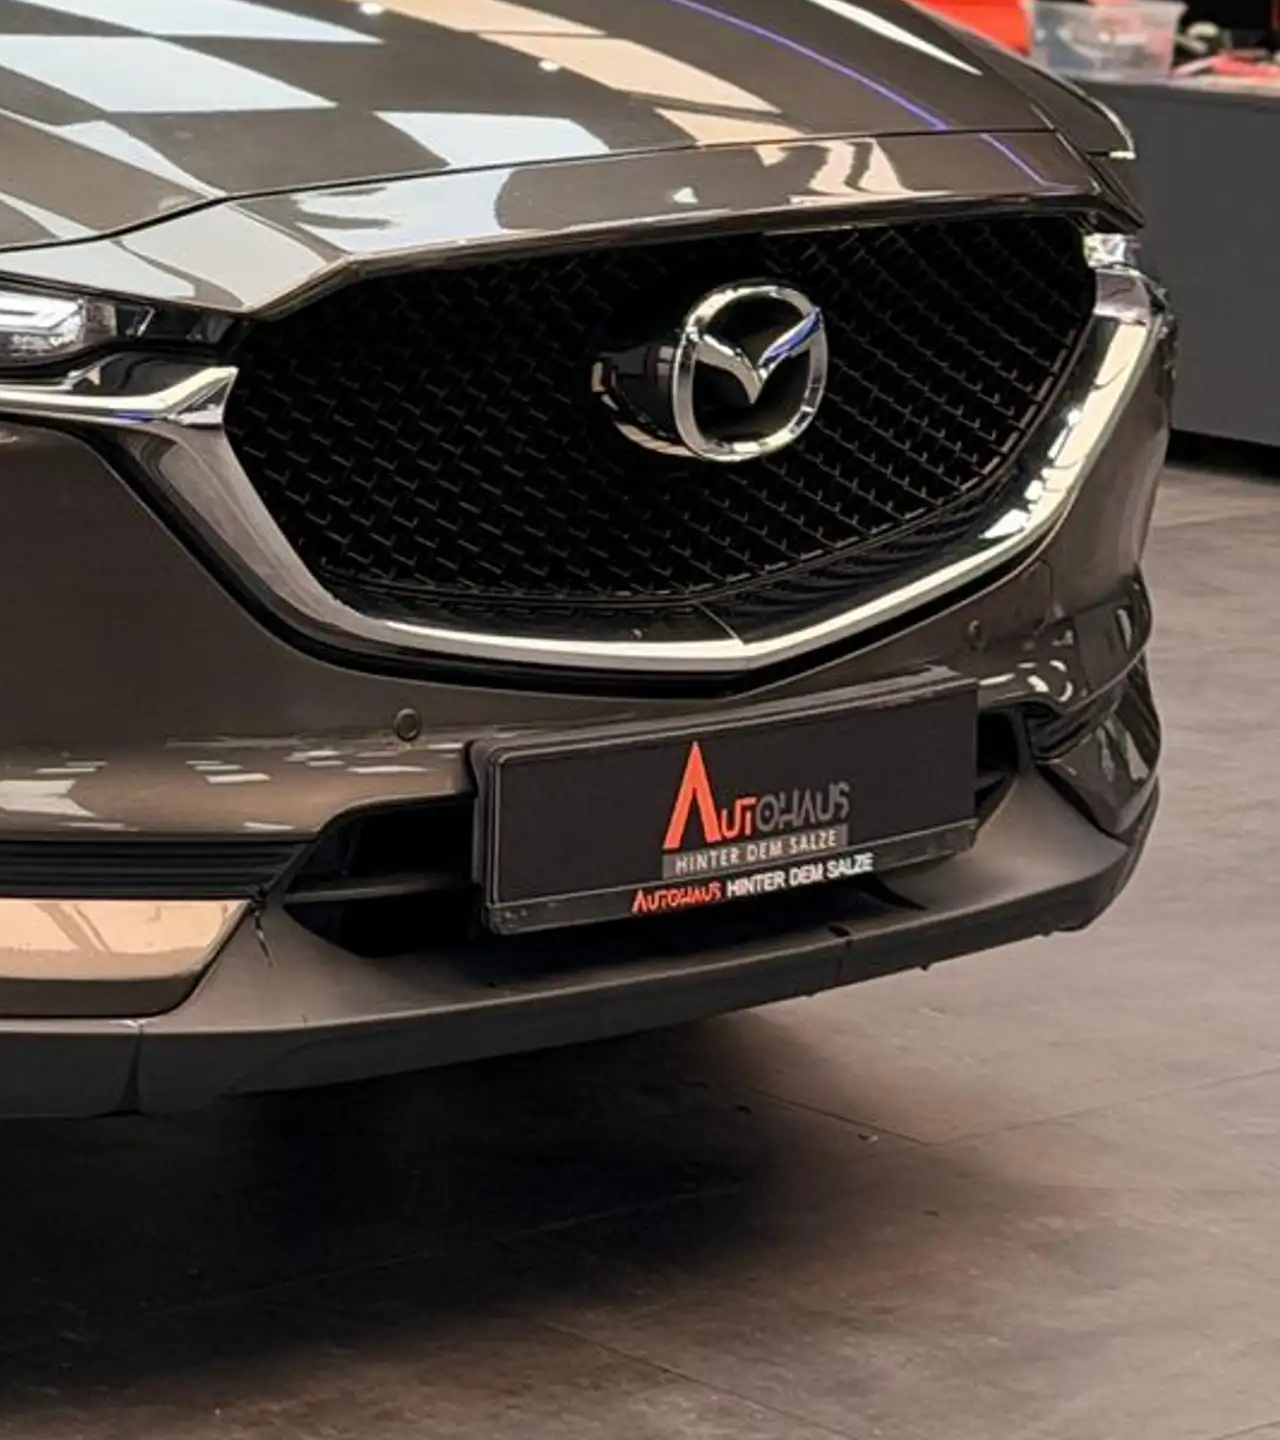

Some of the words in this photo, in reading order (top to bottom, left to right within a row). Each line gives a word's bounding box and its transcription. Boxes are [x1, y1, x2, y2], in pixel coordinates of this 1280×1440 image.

[674, 846, 741, 875] HINTER
[746, 838, 785, 861] DEM
[789, 828, 838, 855] SALZE
[726, 871, 786, 898] HINTER
[789, 862, 825, 886] DEM
[826, 851, 875, 879] SALZE
